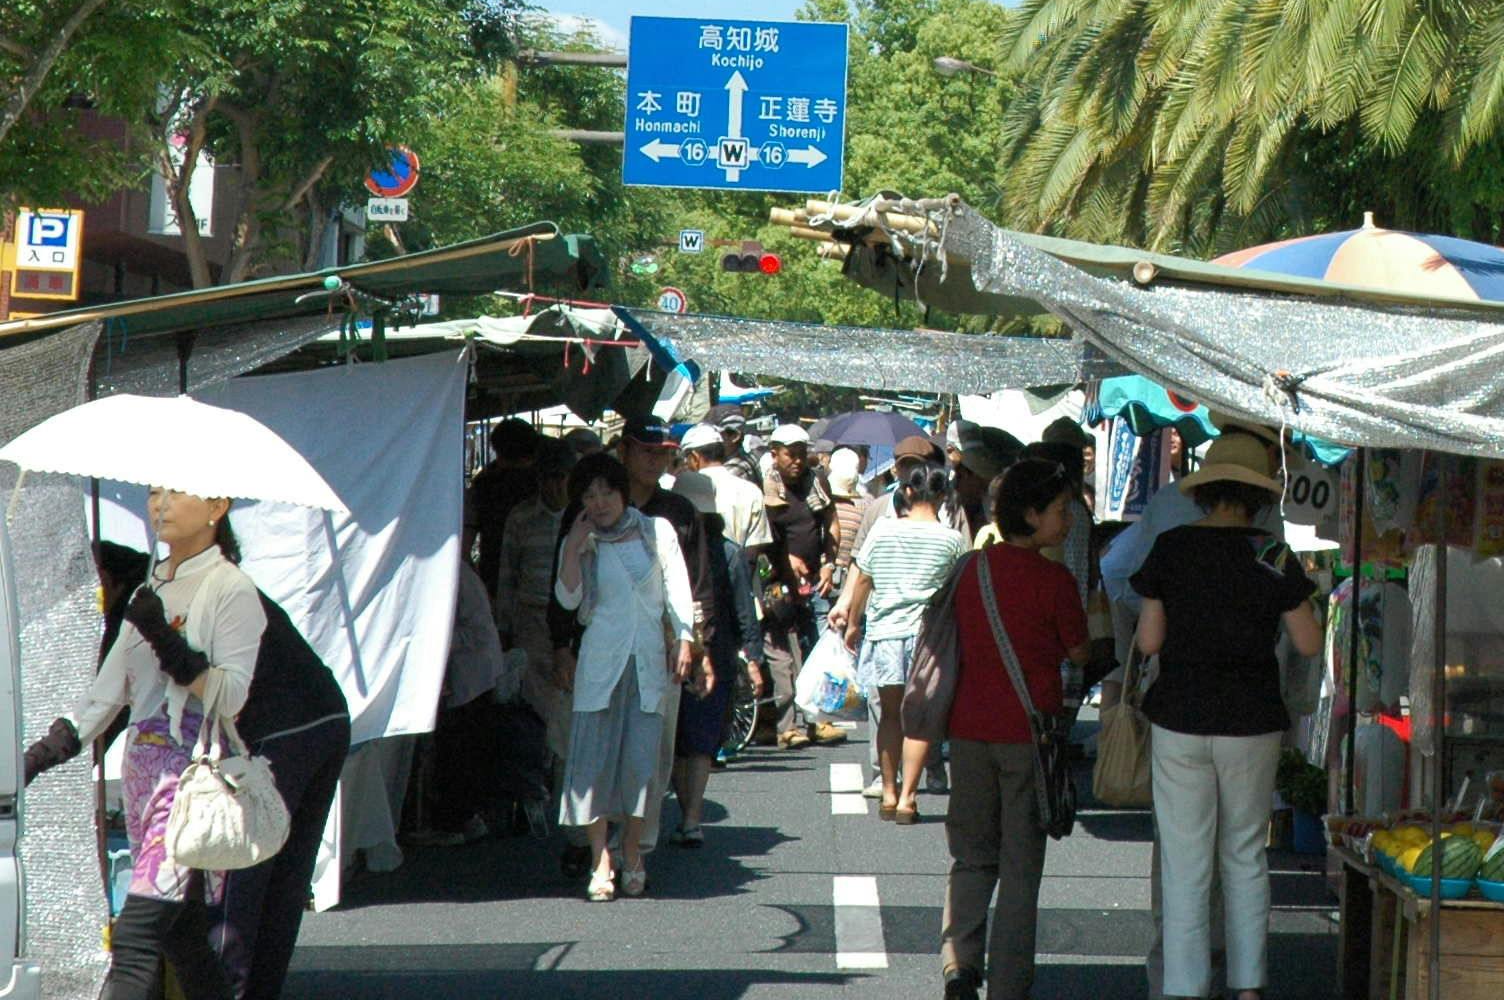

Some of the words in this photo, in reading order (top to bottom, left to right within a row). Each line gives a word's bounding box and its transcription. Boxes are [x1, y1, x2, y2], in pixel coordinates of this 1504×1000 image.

[699, 25, 779, 53] 高知城
[711, 53, 764, 71] Kochijo
[637, 90, 701, 117] 本町
[758, 96, 838, 124] 正蓮寺
[635, 118, 701, 133] Honmachi
[769, 124, 826, 142] Shorenji
[685, 143, 704, 160] 16
[723, 144, 743, 162] W
[764, 147, 782, 164] 16
[32, 218, 65, 245] P
[684, 235, 699, 248] W
[28, 249, 65, 263] 入口
[661, 295, 679, 310] 40
